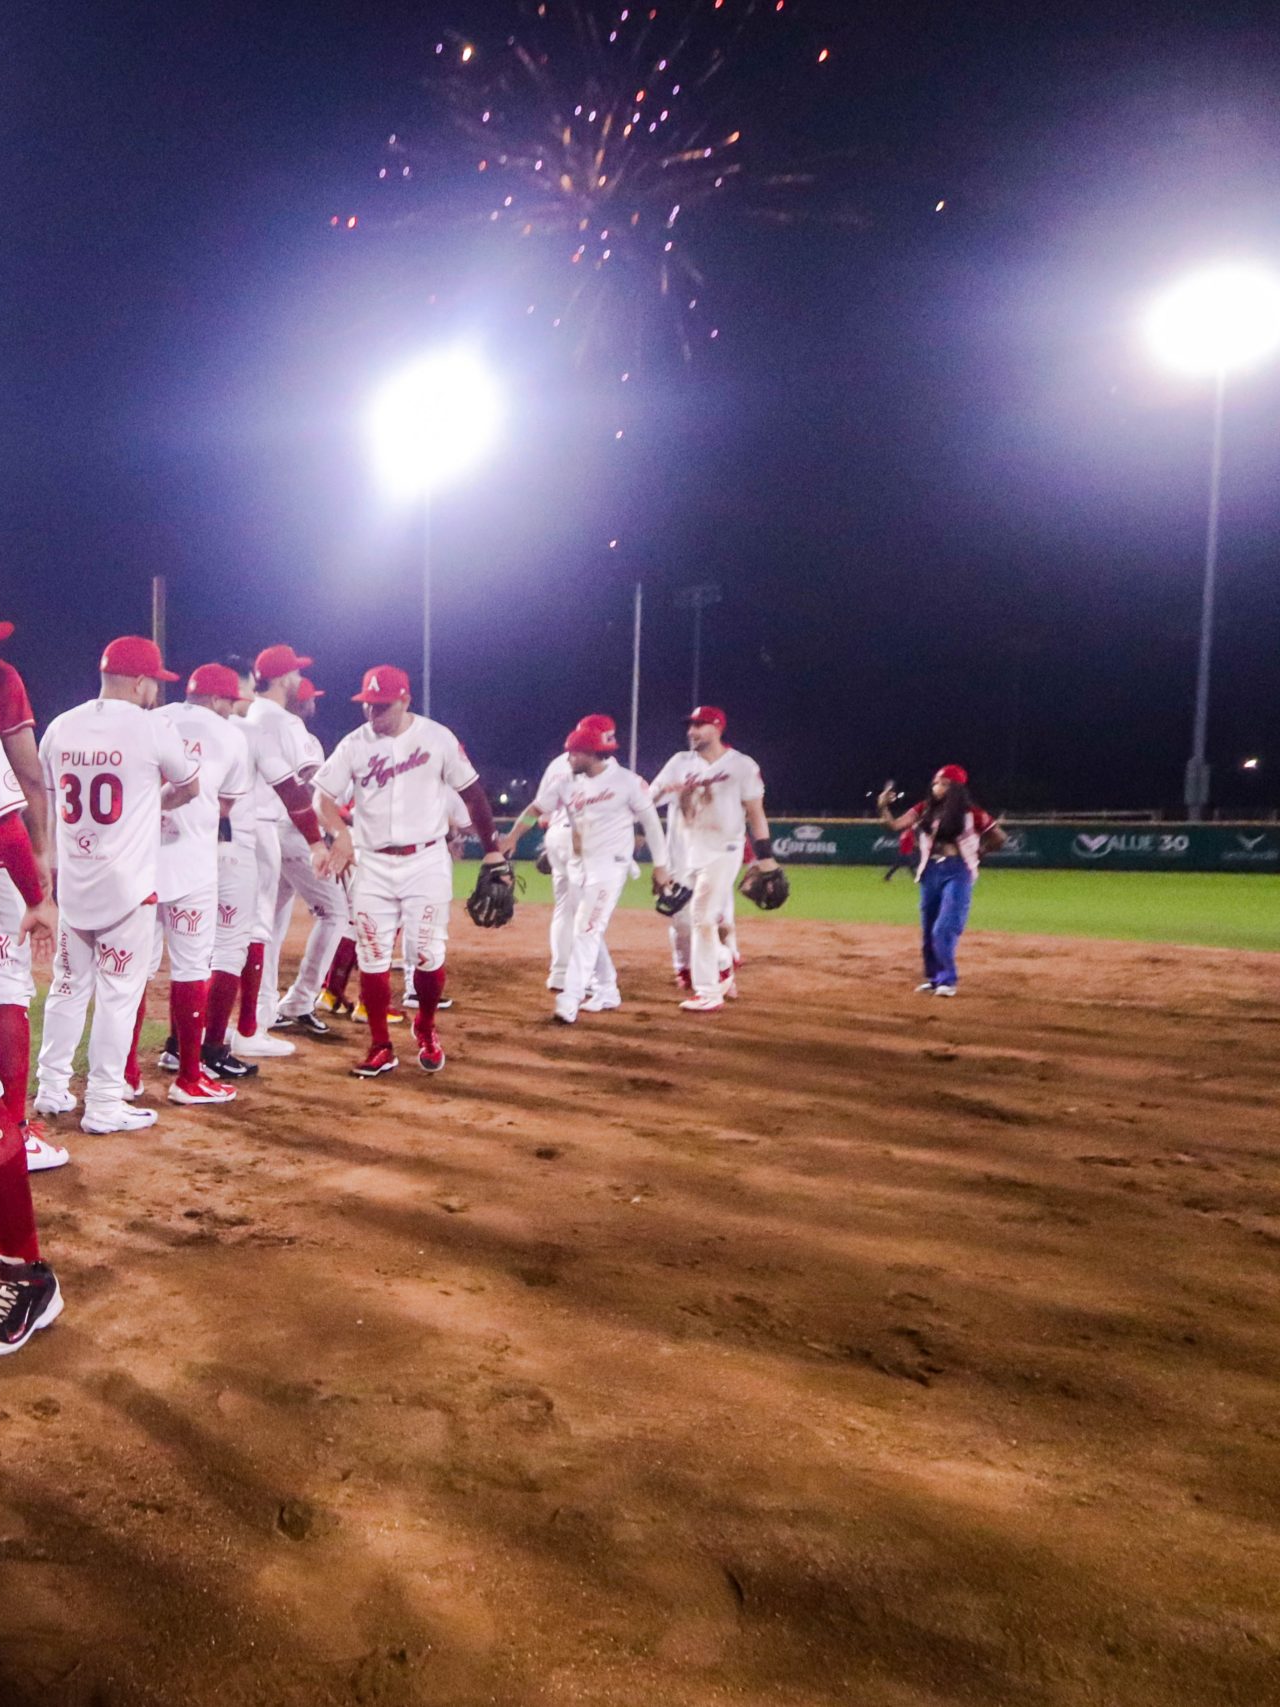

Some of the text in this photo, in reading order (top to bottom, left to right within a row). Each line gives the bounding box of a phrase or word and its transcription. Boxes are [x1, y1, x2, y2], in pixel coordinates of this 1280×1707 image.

[61, 750, 123, 767] PULIDO
[60, 773, 123, 825] 30
[772, 837, 837, 855] Corona
[1159, 834, 1190, 851] 30
